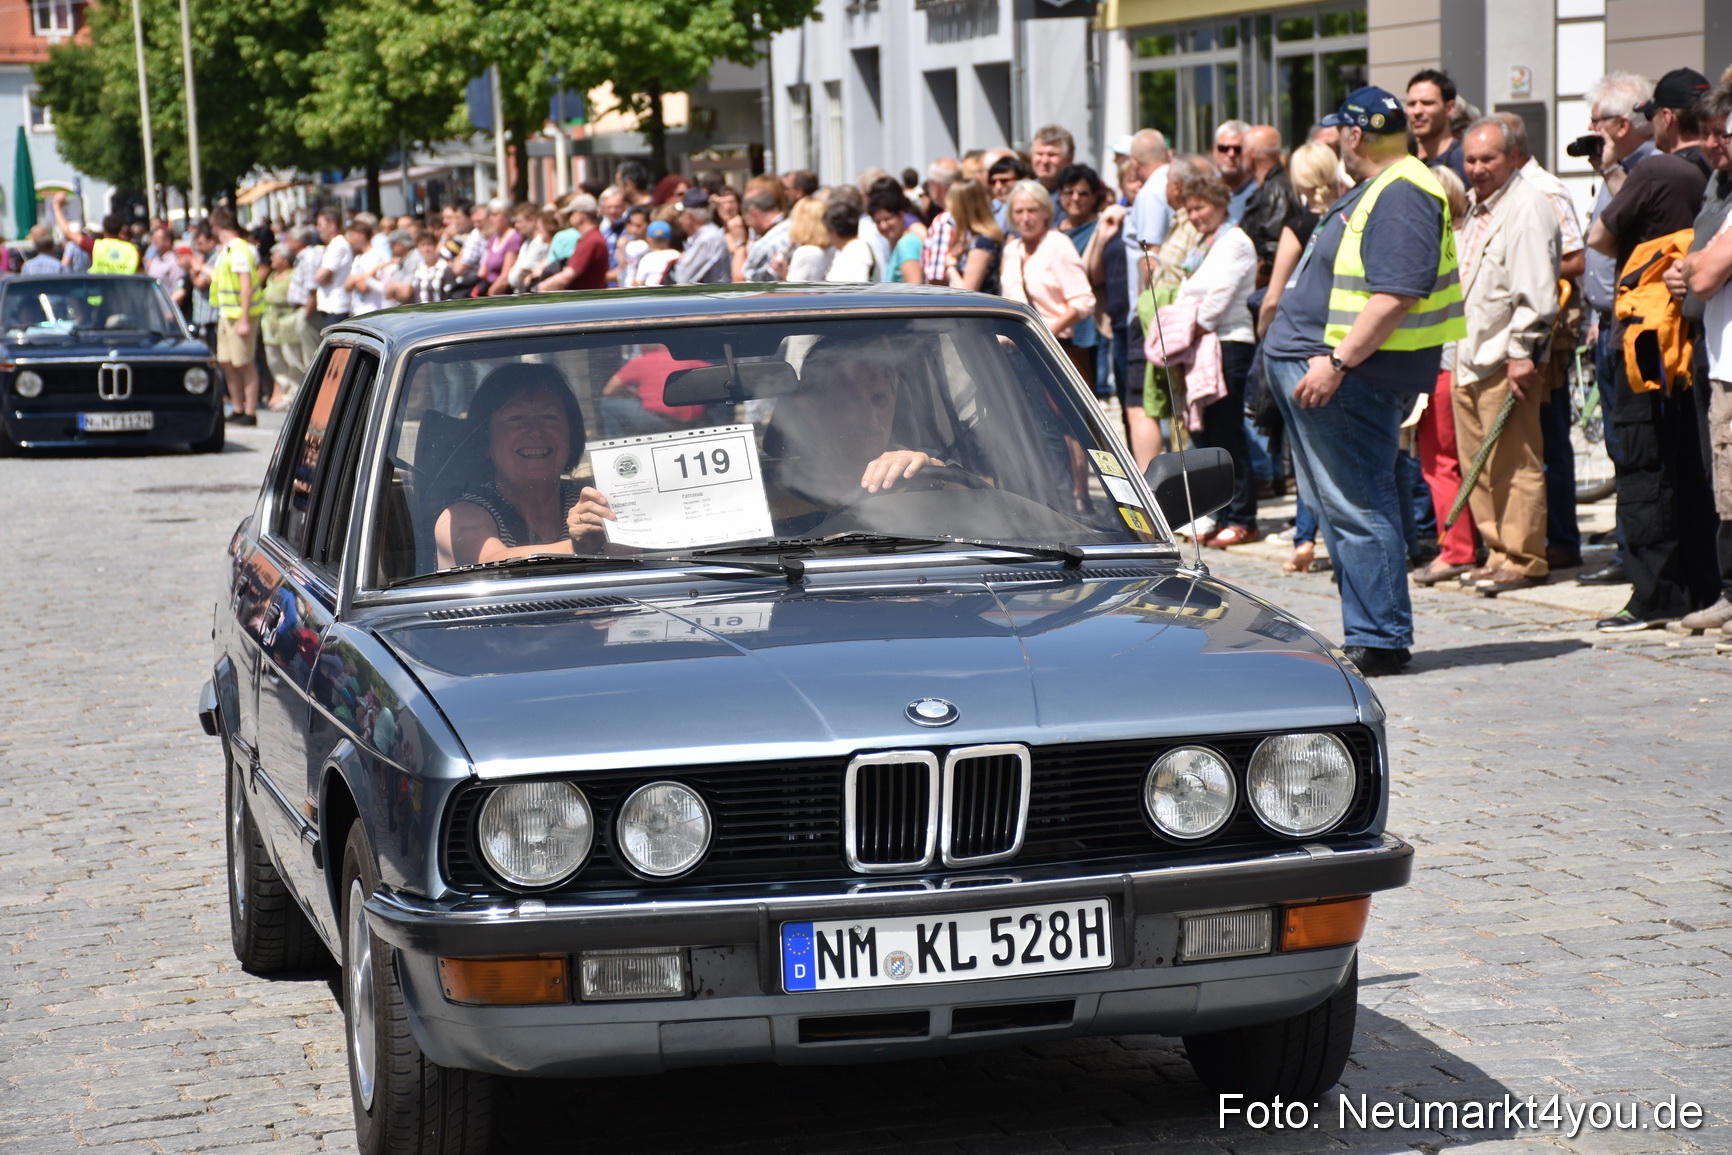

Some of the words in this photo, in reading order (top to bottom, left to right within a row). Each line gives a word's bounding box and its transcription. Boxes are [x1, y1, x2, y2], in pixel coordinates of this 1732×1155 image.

[673, 448, 731, 479] 119
[816, 926, 879, 980] NM
[916, 922, 977, 974] KL
[989, 906, 1106, 967] 528H
[794, 964, 806, 979] D
